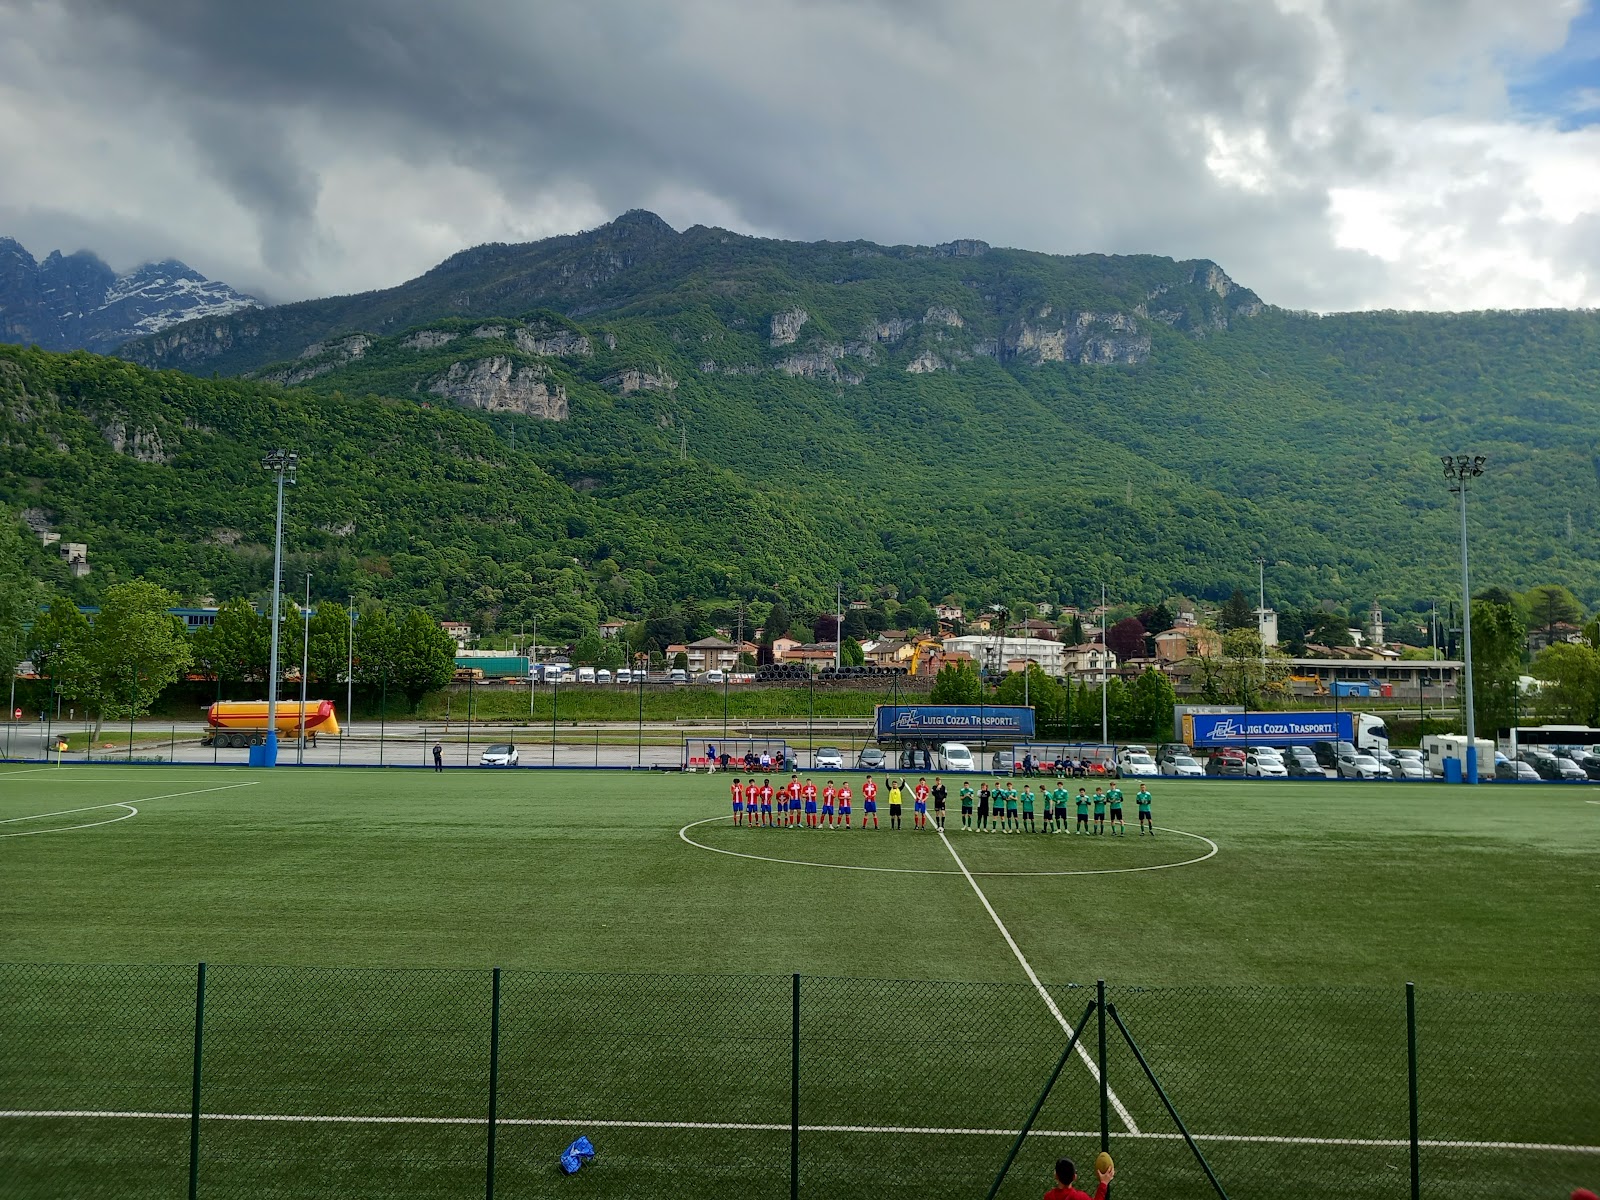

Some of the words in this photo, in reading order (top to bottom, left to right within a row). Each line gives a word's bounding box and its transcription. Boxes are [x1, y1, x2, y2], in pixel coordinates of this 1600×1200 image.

[922, 716, 944, 724] LUIGI
[946, 715, 970, 725] COZZA
[970, 716, 1013, 726] TRASPORTI
[1240, 724, 1262, 734] LUIGI
[1264, 724, 1288, 734] COZZA
[1289, 723, 1332, 733] TRASPORTI
